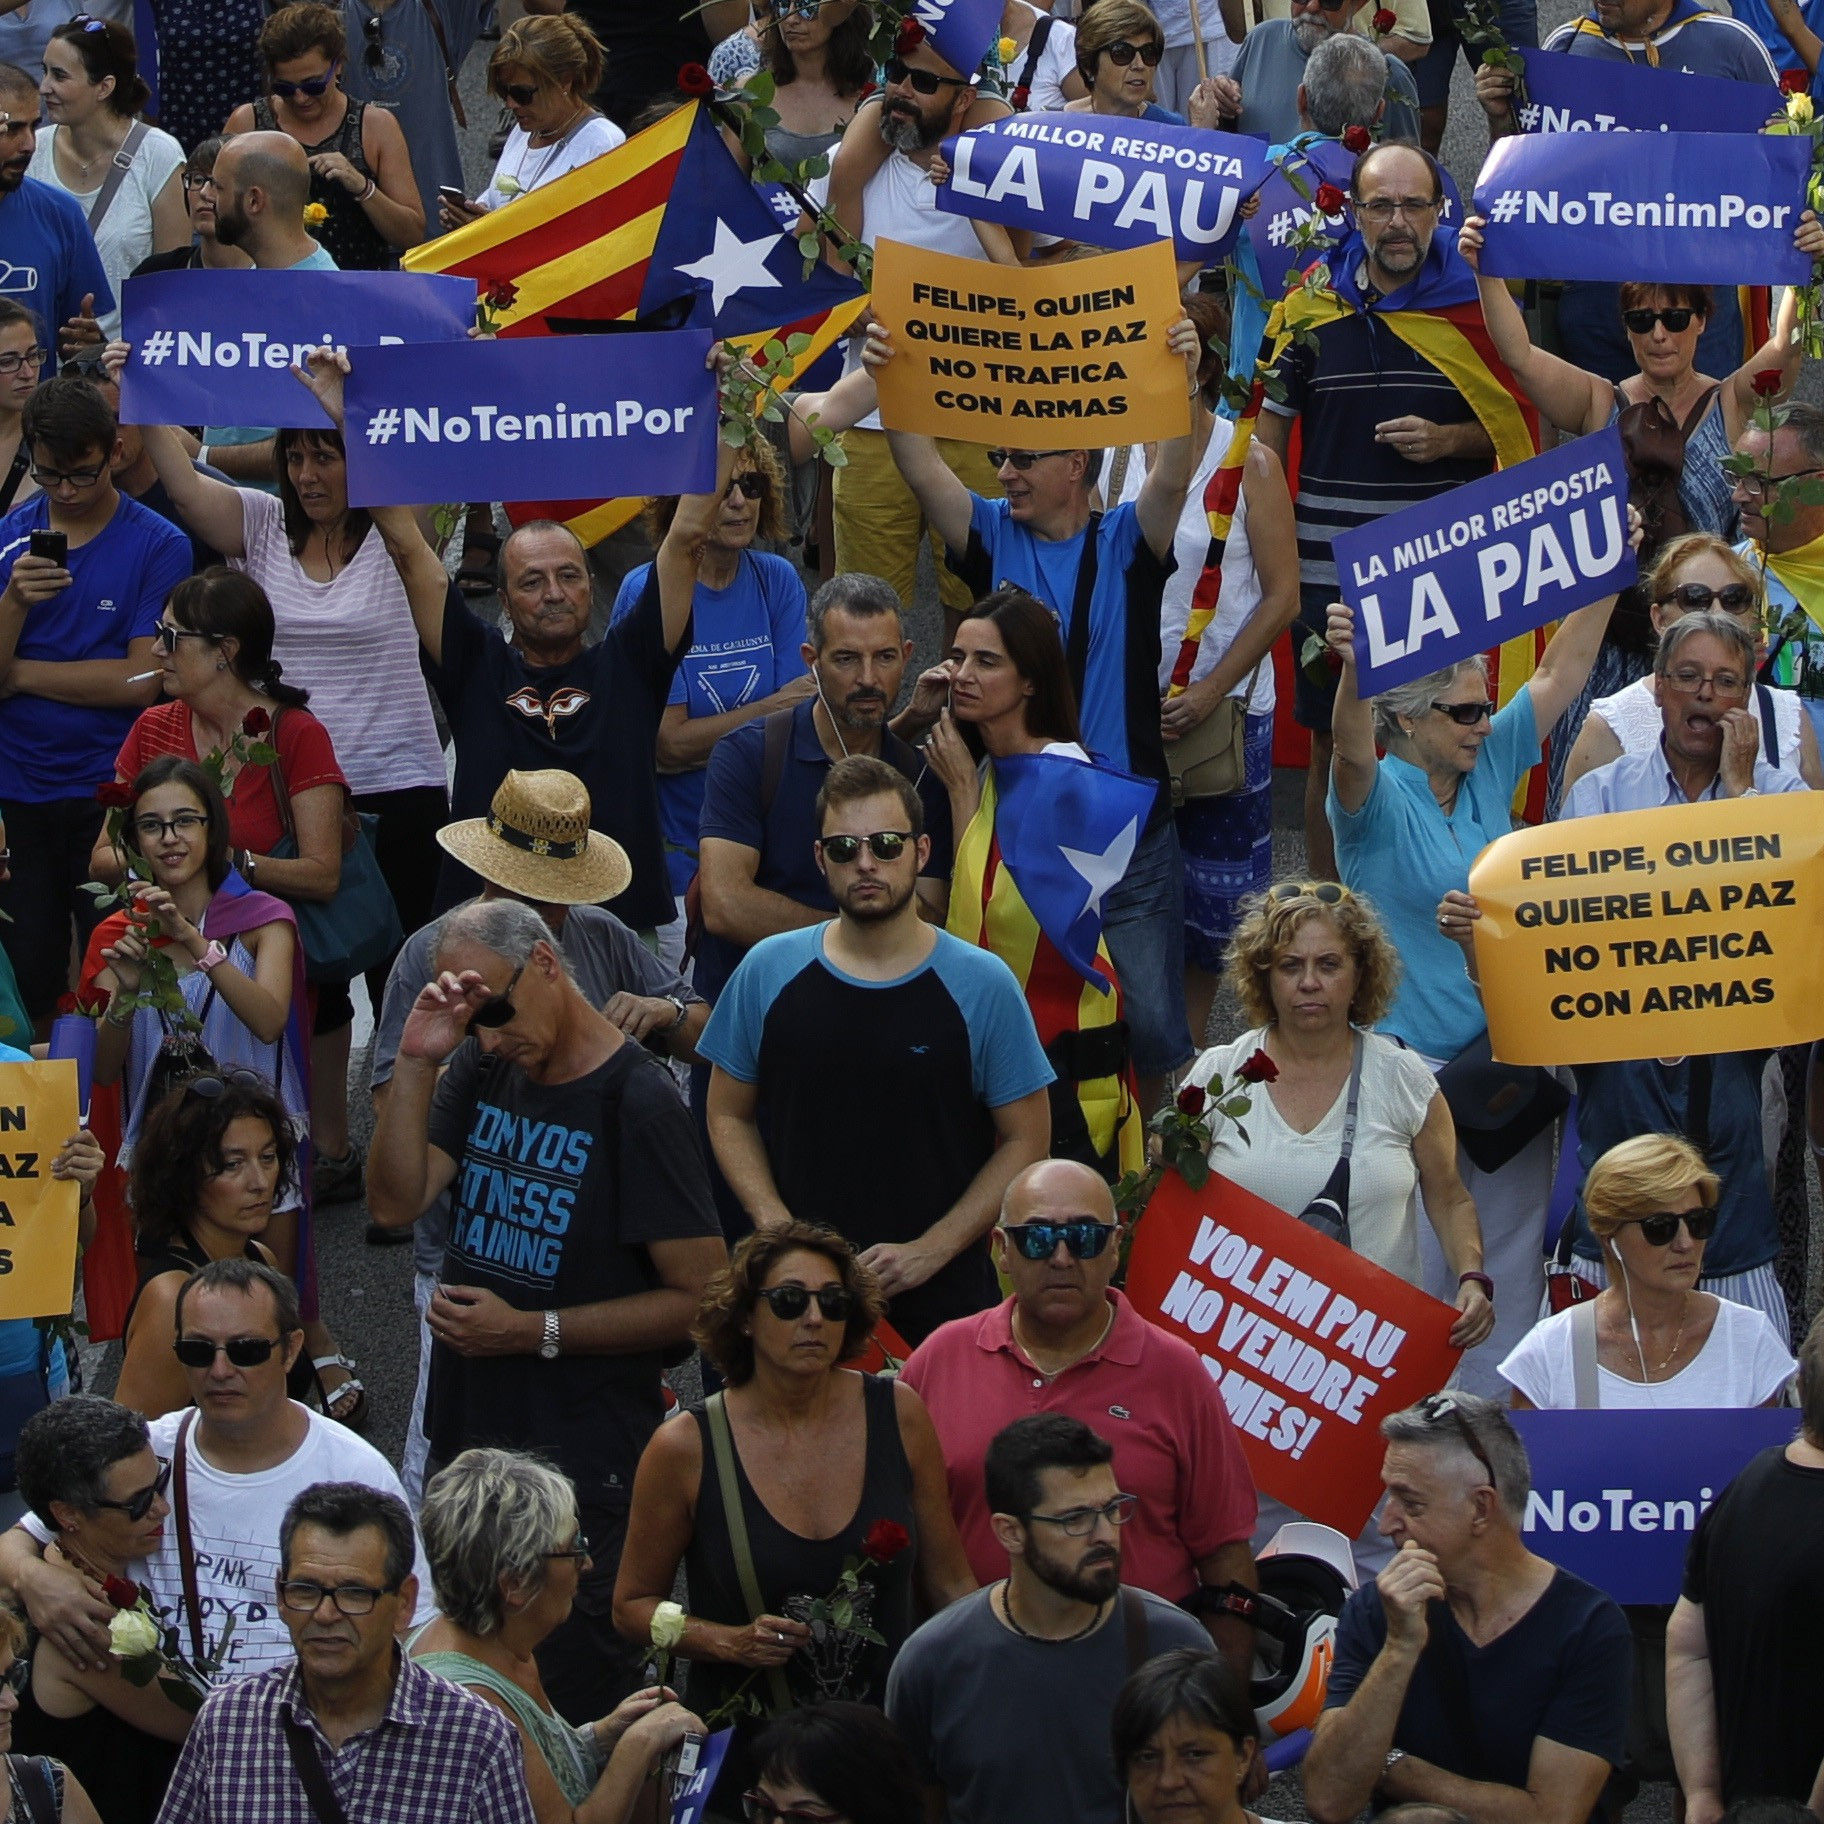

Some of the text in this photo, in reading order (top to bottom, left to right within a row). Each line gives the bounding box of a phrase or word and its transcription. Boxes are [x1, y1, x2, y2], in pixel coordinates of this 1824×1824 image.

[365, 400, 694, 445] #NoTenimPor
[1352, 462, 1613, 587] LA MILLOR RESPOSTA
[1360, 495, 1623, 669] LA PAU
[1161, 1270, 1380, 1424] NO VENDRE
[1189, 1215, 1407, 1377] VOLEM PAU,
